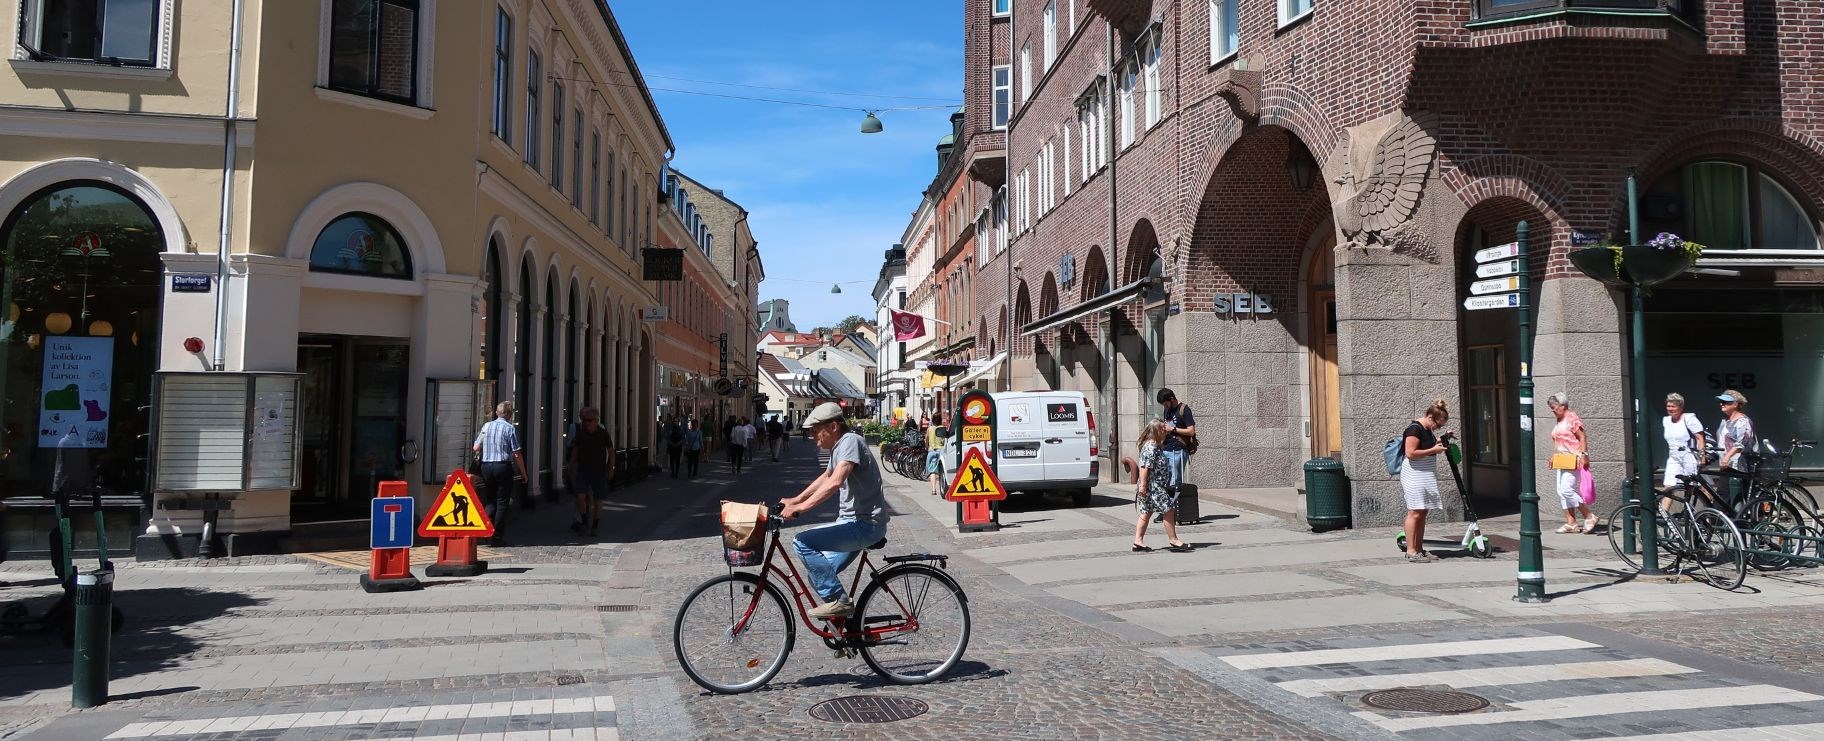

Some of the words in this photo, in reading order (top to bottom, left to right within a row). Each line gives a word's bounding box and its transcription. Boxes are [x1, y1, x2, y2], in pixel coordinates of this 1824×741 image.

[1058, 252, 1075, 283] SEB
[175, 276, 207, 285] Stortorget
[1214, 293, 1273, 314] SEB
[53, 343, 73, 351] Unik
[52, 353, 92, 361] kollektion
[62, 362, 80, 370] Lisa
[1707, 372, 1756, 389] SEB
[1050, 412, 1075, 420] LOOMIS
